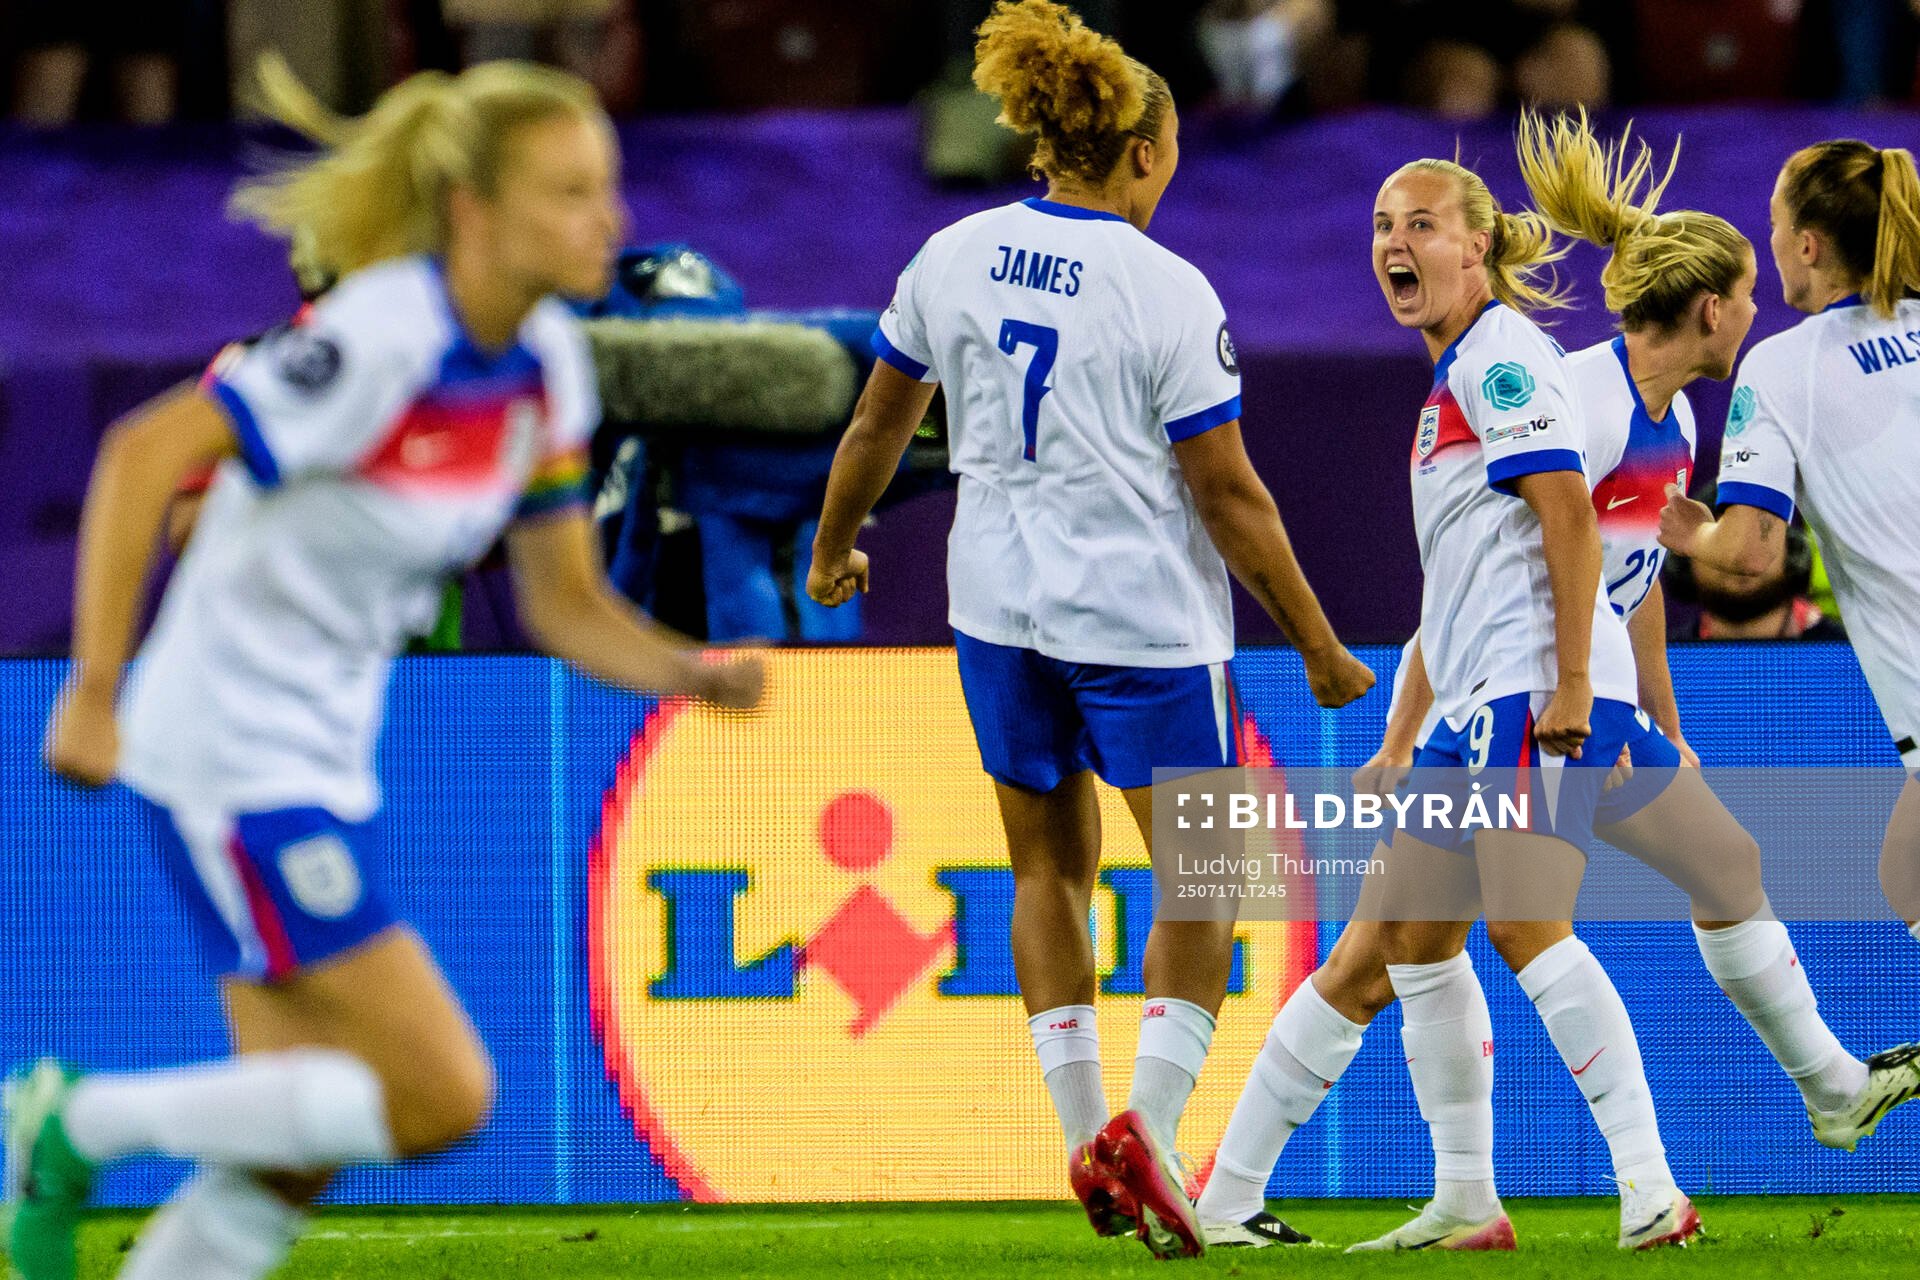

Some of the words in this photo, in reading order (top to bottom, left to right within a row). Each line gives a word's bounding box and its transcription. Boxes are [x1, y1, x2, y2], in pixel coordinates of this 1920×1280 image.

[990, 245, 1083, 297] JAMES
[998, 318, 1059, 463] 7
[1606, 548, 1659, 617] 23
[1468, 705, 1494, 776] 9
